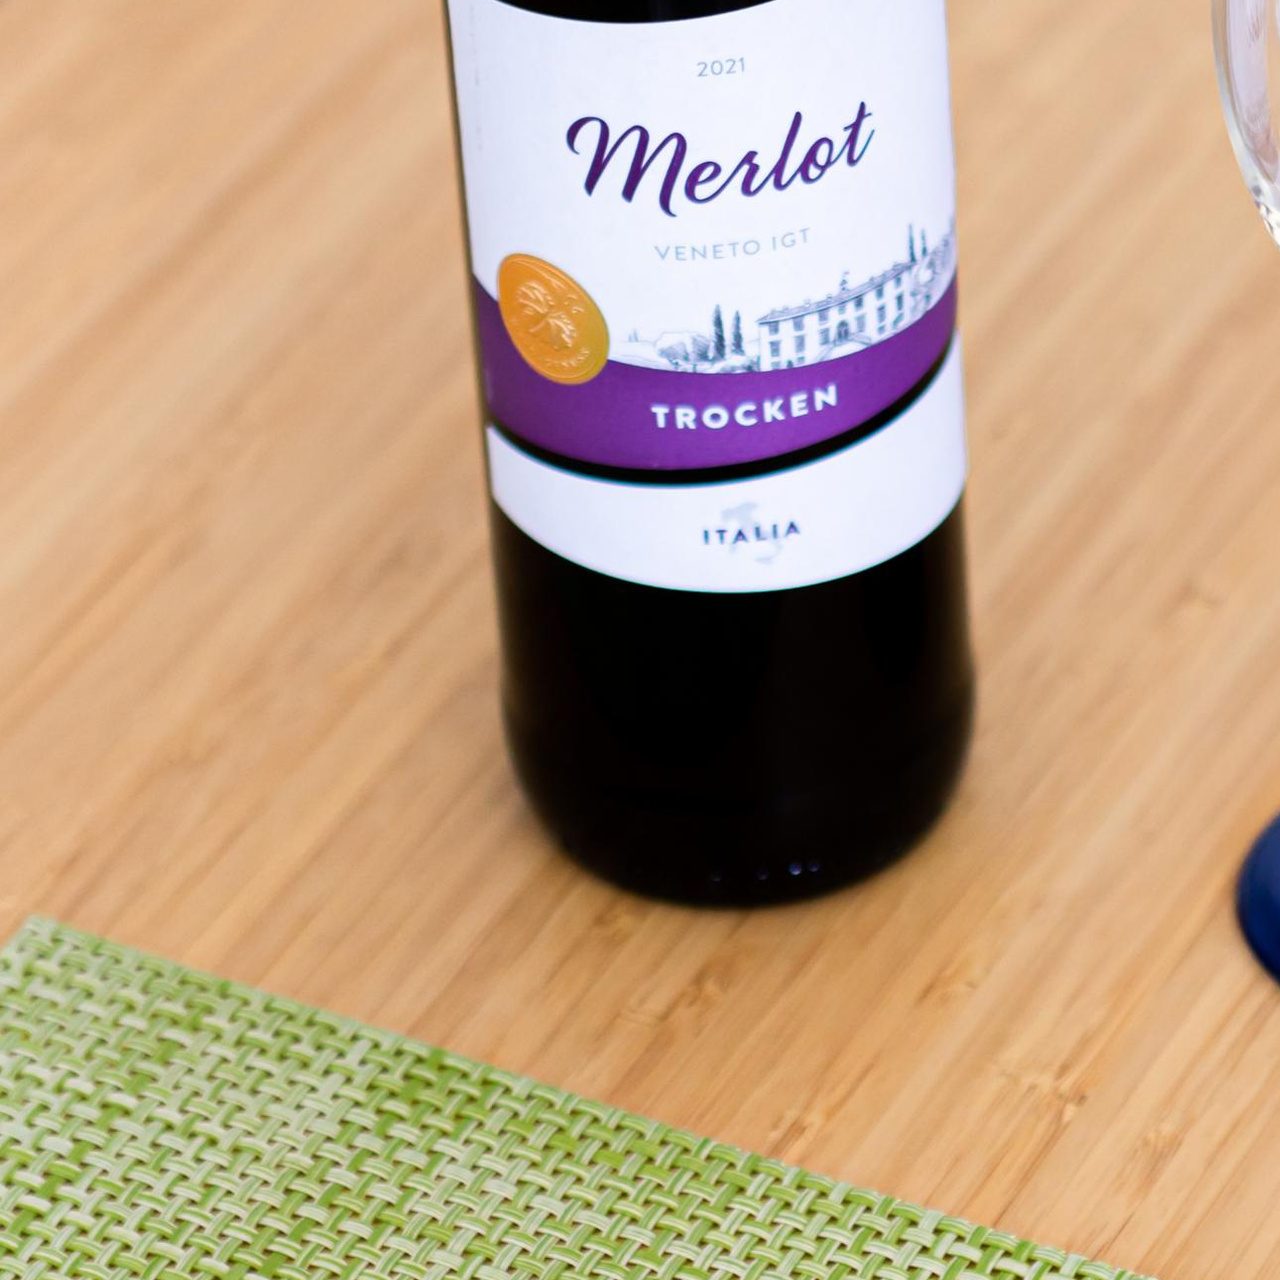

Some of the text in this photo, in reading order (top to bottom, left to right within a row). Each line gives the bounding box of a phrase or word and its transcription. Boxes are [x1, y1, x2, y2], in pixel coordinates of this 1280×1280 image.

[697, 57, 746, 77] 2021
[566, 101, 875, 217] Merlot
[654, 228, 810, 261] VENETO IGT
[651, 383, 837, 429] TROCKEN
[702, 521, 800, 545] ITALIA
